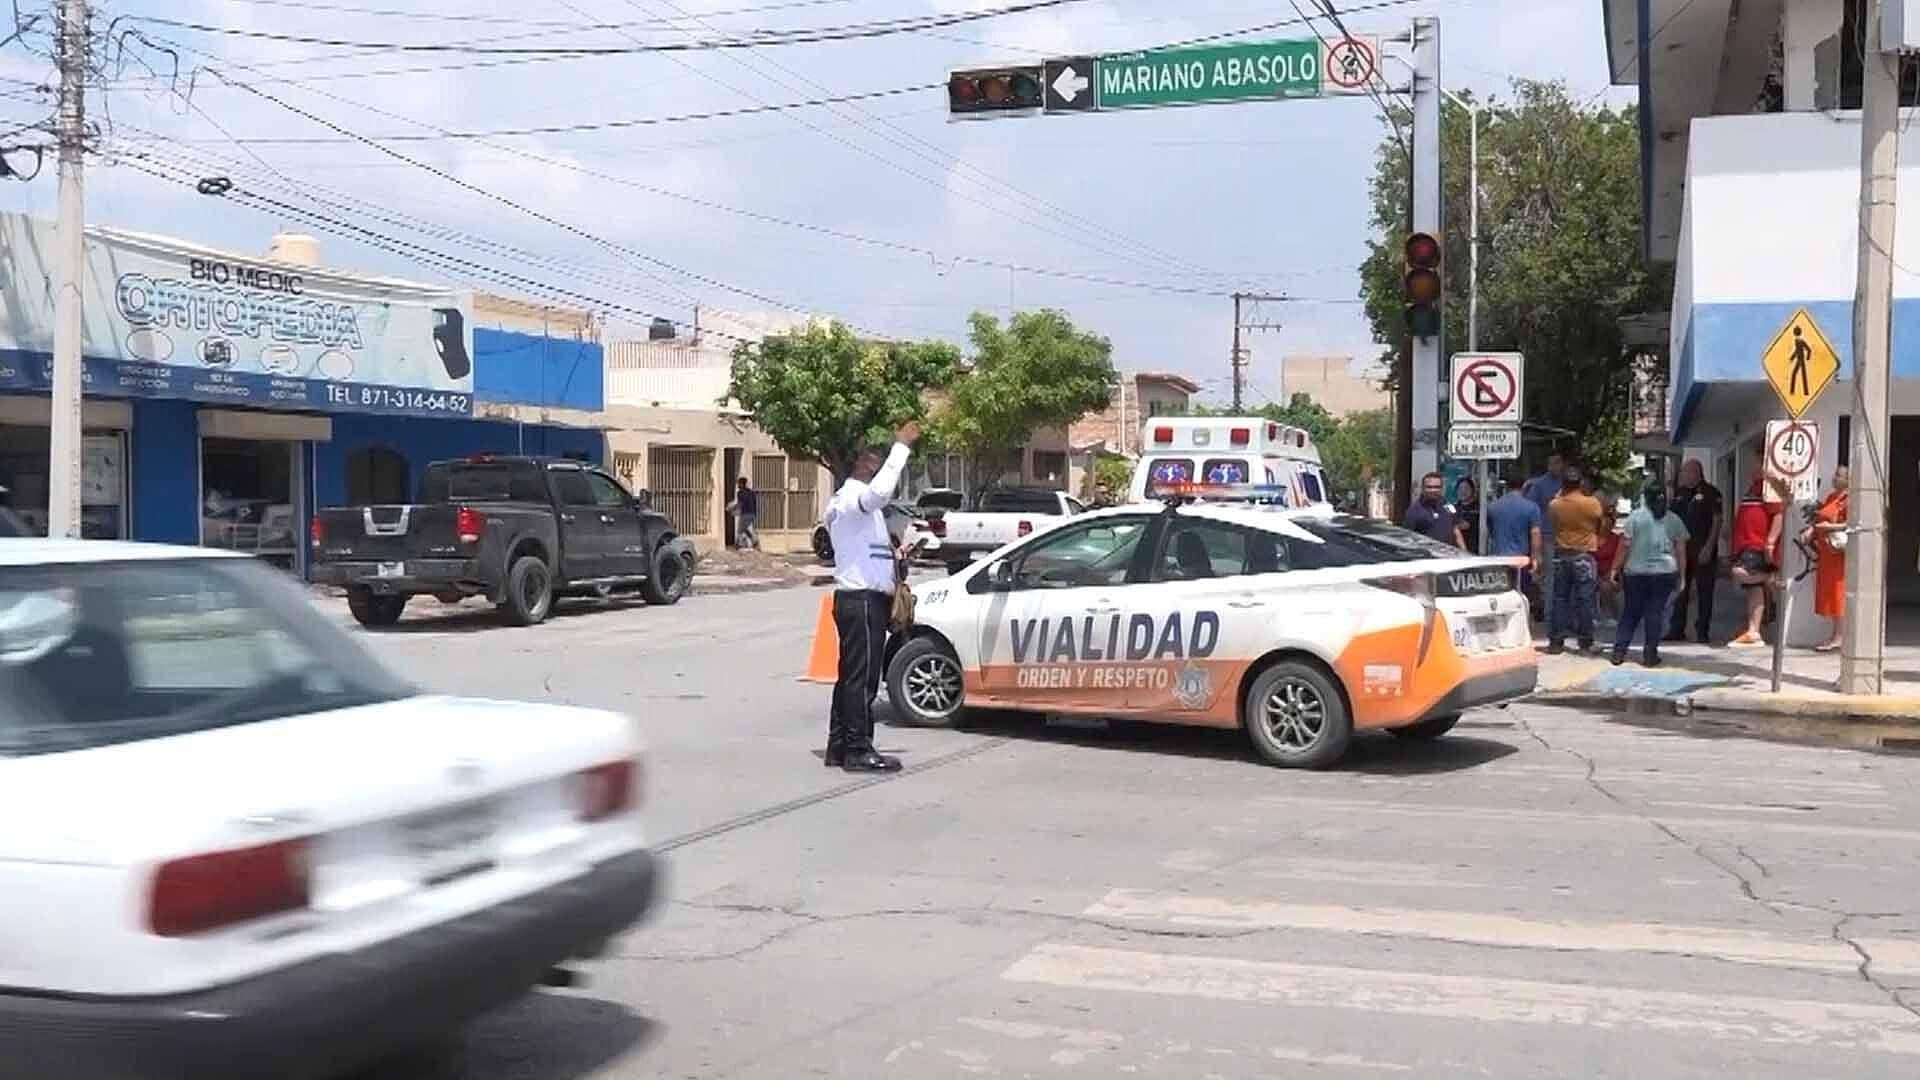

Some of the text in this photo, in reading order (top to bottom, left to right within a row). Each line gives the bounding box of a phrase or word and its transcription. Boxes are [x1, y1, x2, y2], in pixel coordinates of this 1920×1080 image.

[1104, 52, 1316, 94] MARIANO ABASOLO
[190, 258, 303, 296] BIO MEDIC
[115, 272, 364, 350] ORTOPEDIA
[327, 384, 355, 404] TEL
[361, 387, 468, 412] 871-314-64-52
[1782, 430, 1805, 456] 40
[1010, 610, 1220, 664] VIALIDAD
[1017, 666, 1169, 689] ORDEN Y RESPETO
